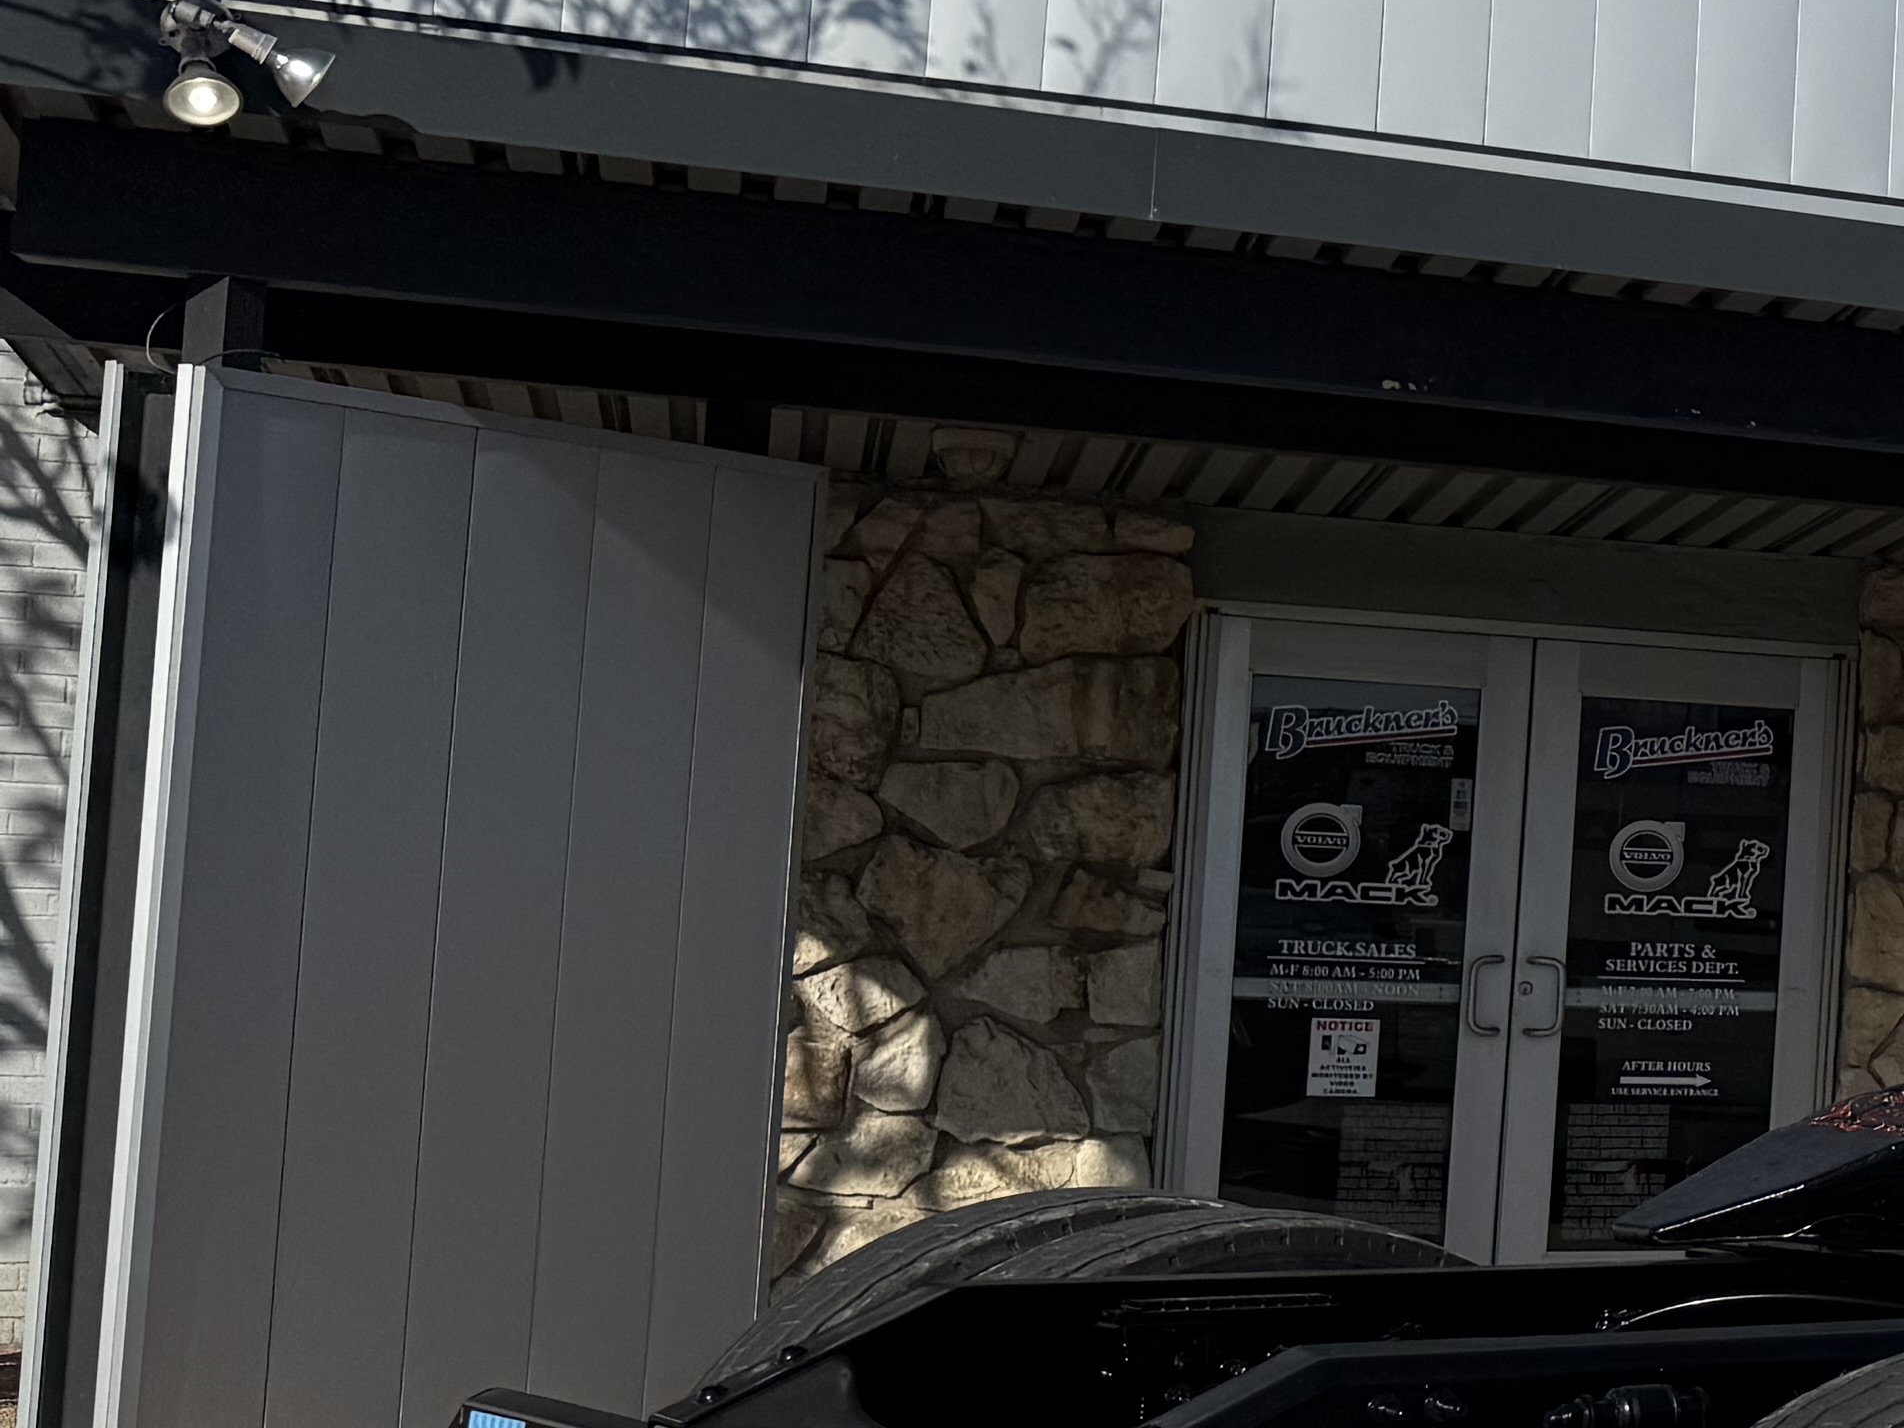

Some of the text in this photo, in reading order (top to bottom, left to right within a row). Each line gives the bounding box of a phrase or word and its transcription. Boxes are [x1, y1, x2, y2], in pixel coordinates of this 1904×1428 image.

[1265, 700, 1458, 760] Bruckner's
[1594, 719, 1773, 779] Bruckner's
[1294, 834, 1348, 845] VOLVO
[1622, 851, 1671, 861] VOLVO
[1275, 879, 1437, 906] MACK
[1604, 893, 1756, 918] MACK
[1278, 939, 1417, 959] TRUCK SALES
[1630, 941, 1717, 959] PARTS &
[1331, 965, 1356, 978] AM
[1368, 966, 1395, 980] 5:00
[1397, 968, 1421, 981] PM
[1605, 959, 1739, 975] SERVICES DEPT.
[1657, 987, 1678, 998] AM
[1714, 988, 1735, 1000] PM
[1267, 997, 1300, 1010] SUN
[1312, 998, 1375, 1012] CLOSED
[1600, 1003, 1627, 1014] SAT
[1719, 1005, 1740, 1017] PM
[1316, 1020, 1374, 1032] NOTICE
[1598, 1018, 1627, 1029] SUN
[1637, 1019, 1693, 1031] CLOSED
[1622, 1061, 1712, 1072] AFTER HOURS
